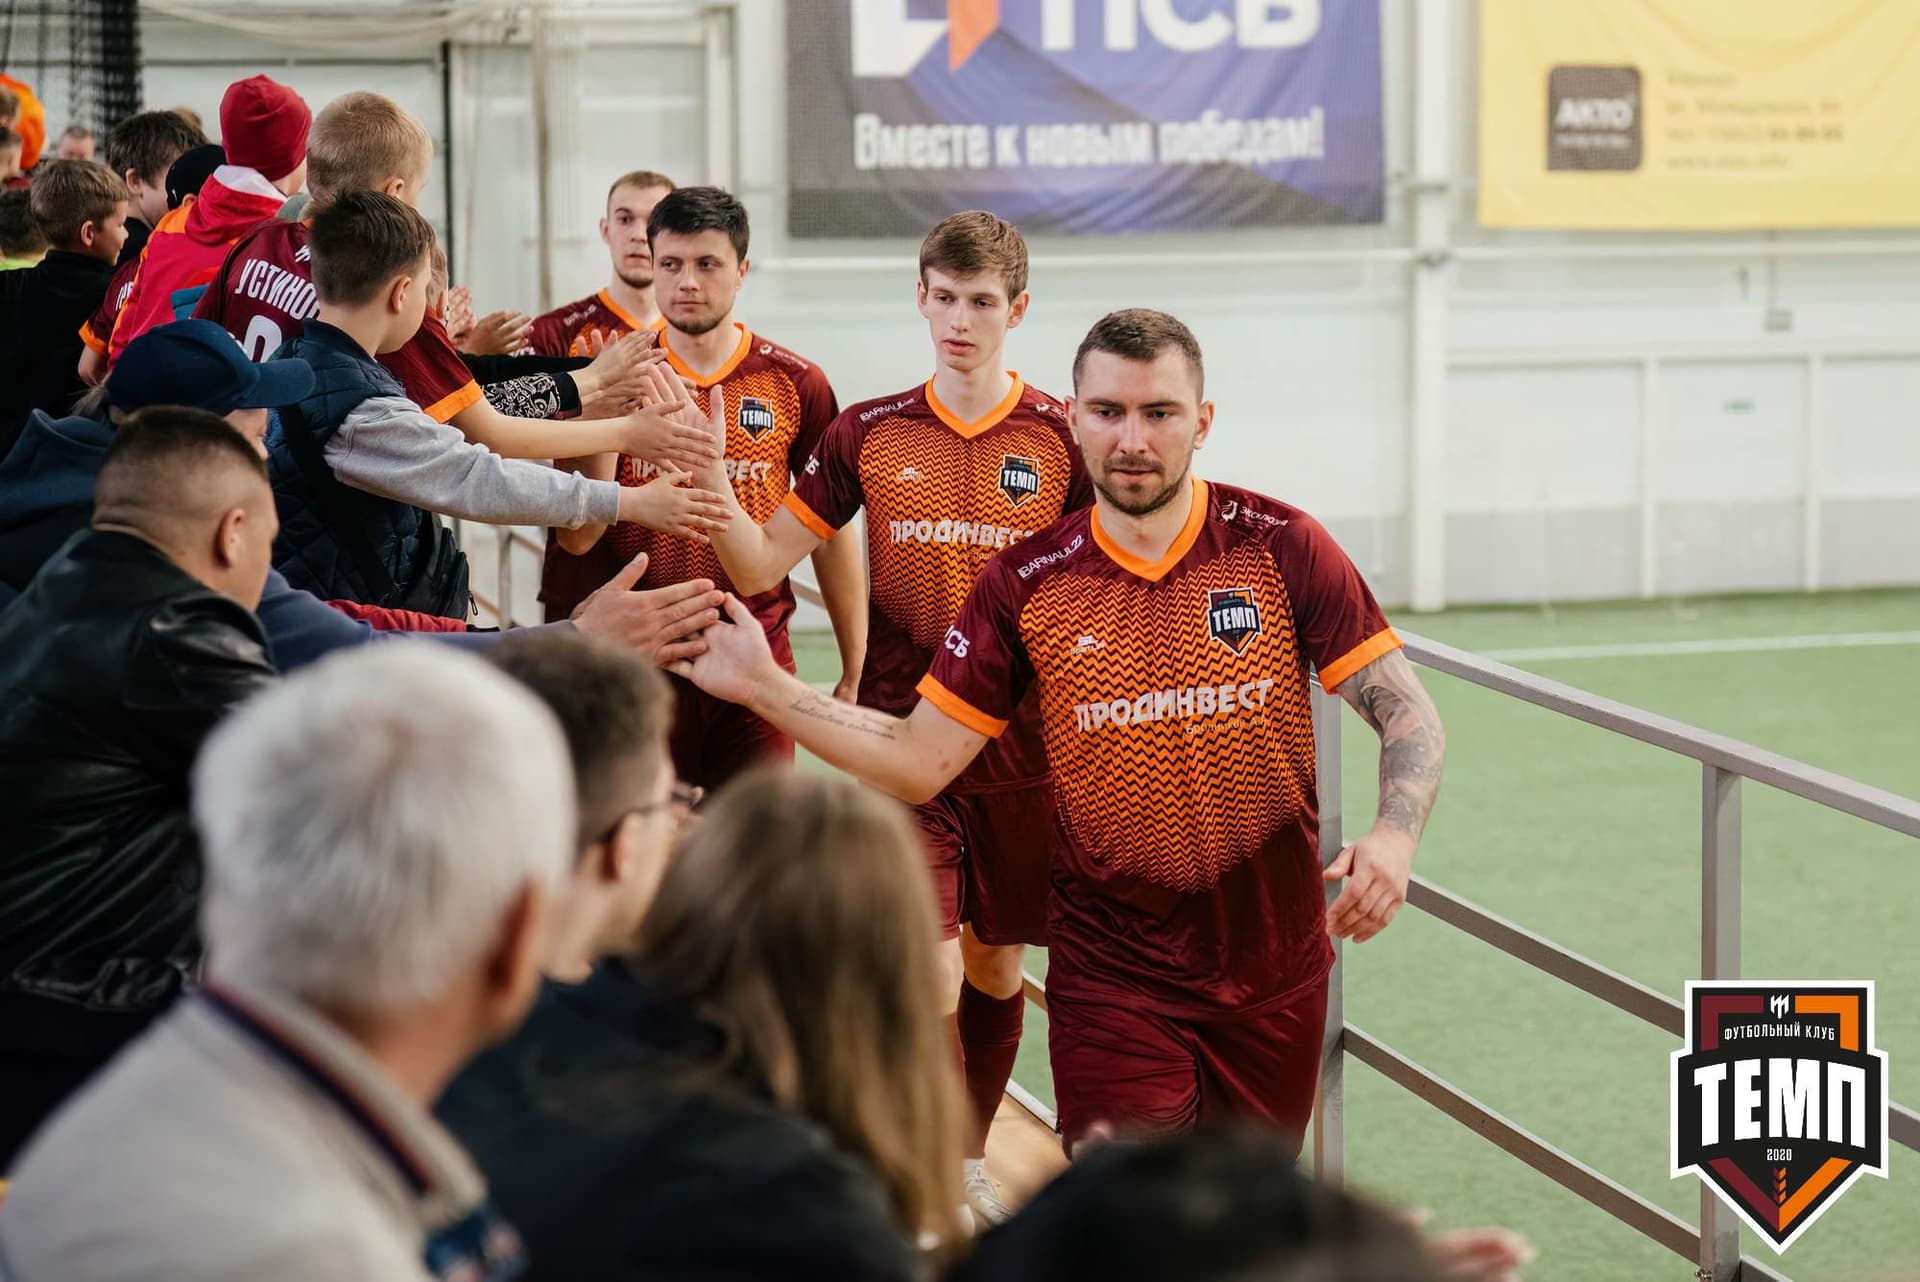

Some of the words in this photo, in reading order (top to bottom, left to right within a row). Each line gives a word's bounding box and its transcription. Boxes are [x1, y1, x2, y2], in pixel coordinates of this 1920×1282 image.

[853, 113, 990, 169] Вместе
[996, 124, 1021, 167] к
[1026, 121, 1154, 166] новым
[1160, 105, 1325, 165] победам!
[742, 410, 771, 429] ТЕМП
[1003, 470, 1036, 492] ТЕМП
[889, 520, 1034, 549] ПРОДИНВЕС
[1212, 606, 1257, 632] ТЕМП
[1073, 678, 1274, 734] ПРОДИНВЕСТ
